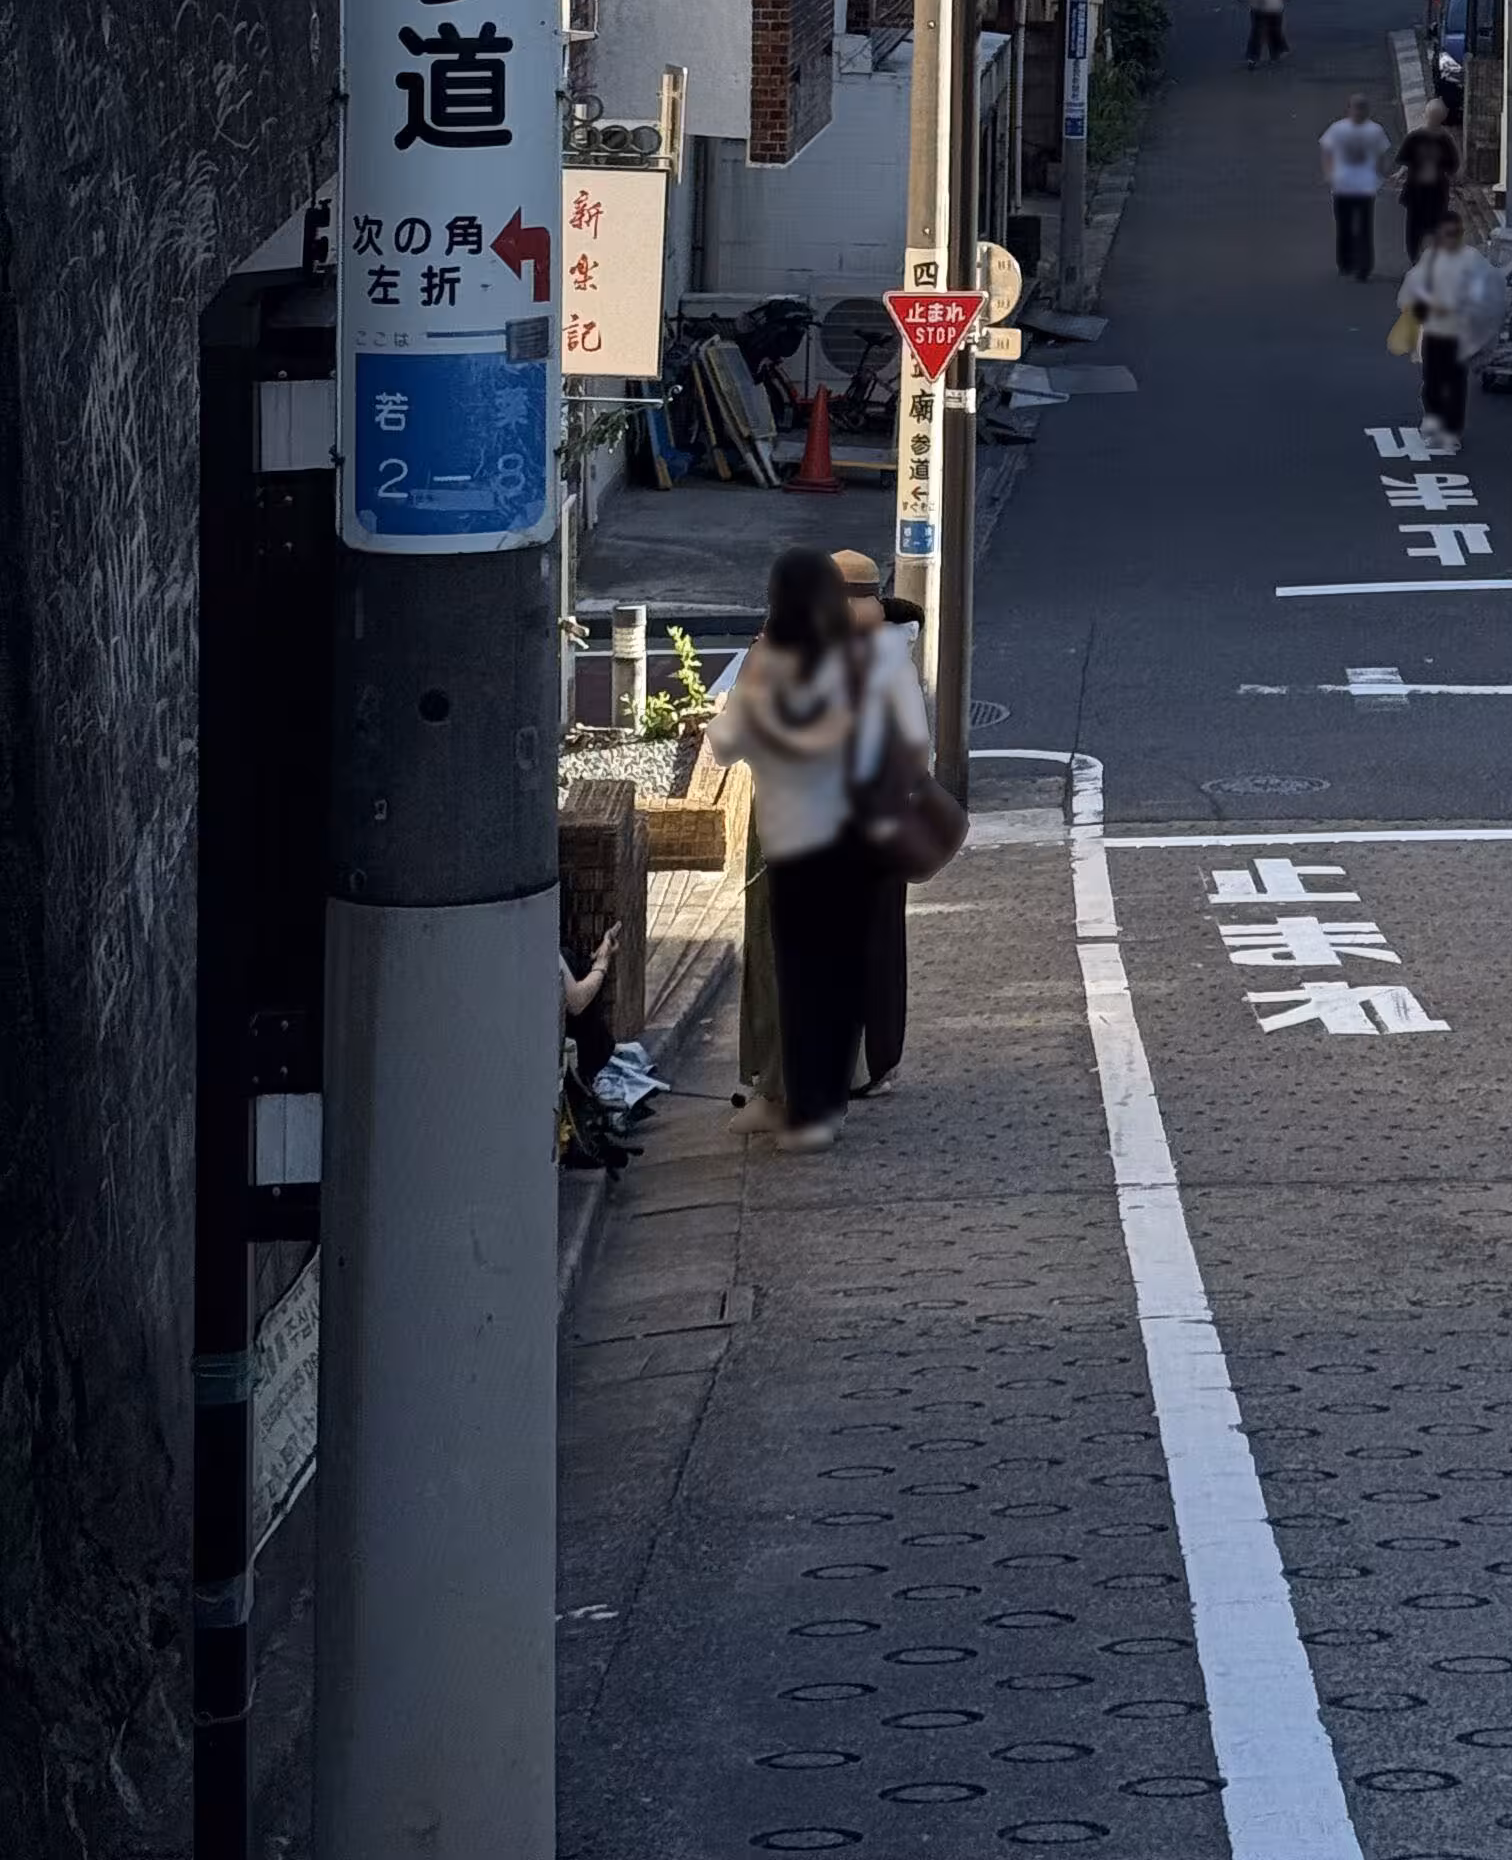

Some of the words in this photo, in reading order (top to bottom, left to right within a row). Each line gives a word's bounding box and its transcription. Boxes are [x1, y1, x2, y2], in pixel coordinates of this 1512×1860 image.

[352, 215, 483, 256] 次の角
[367, 264, 462, 306] 左折
[562, 190, 604, 353] 新楽記
[905, 302, 966, 323] 止まれ
[916, 327, 956, 343] STOP
[1207, 858, 1452, 1034] 止まれ
